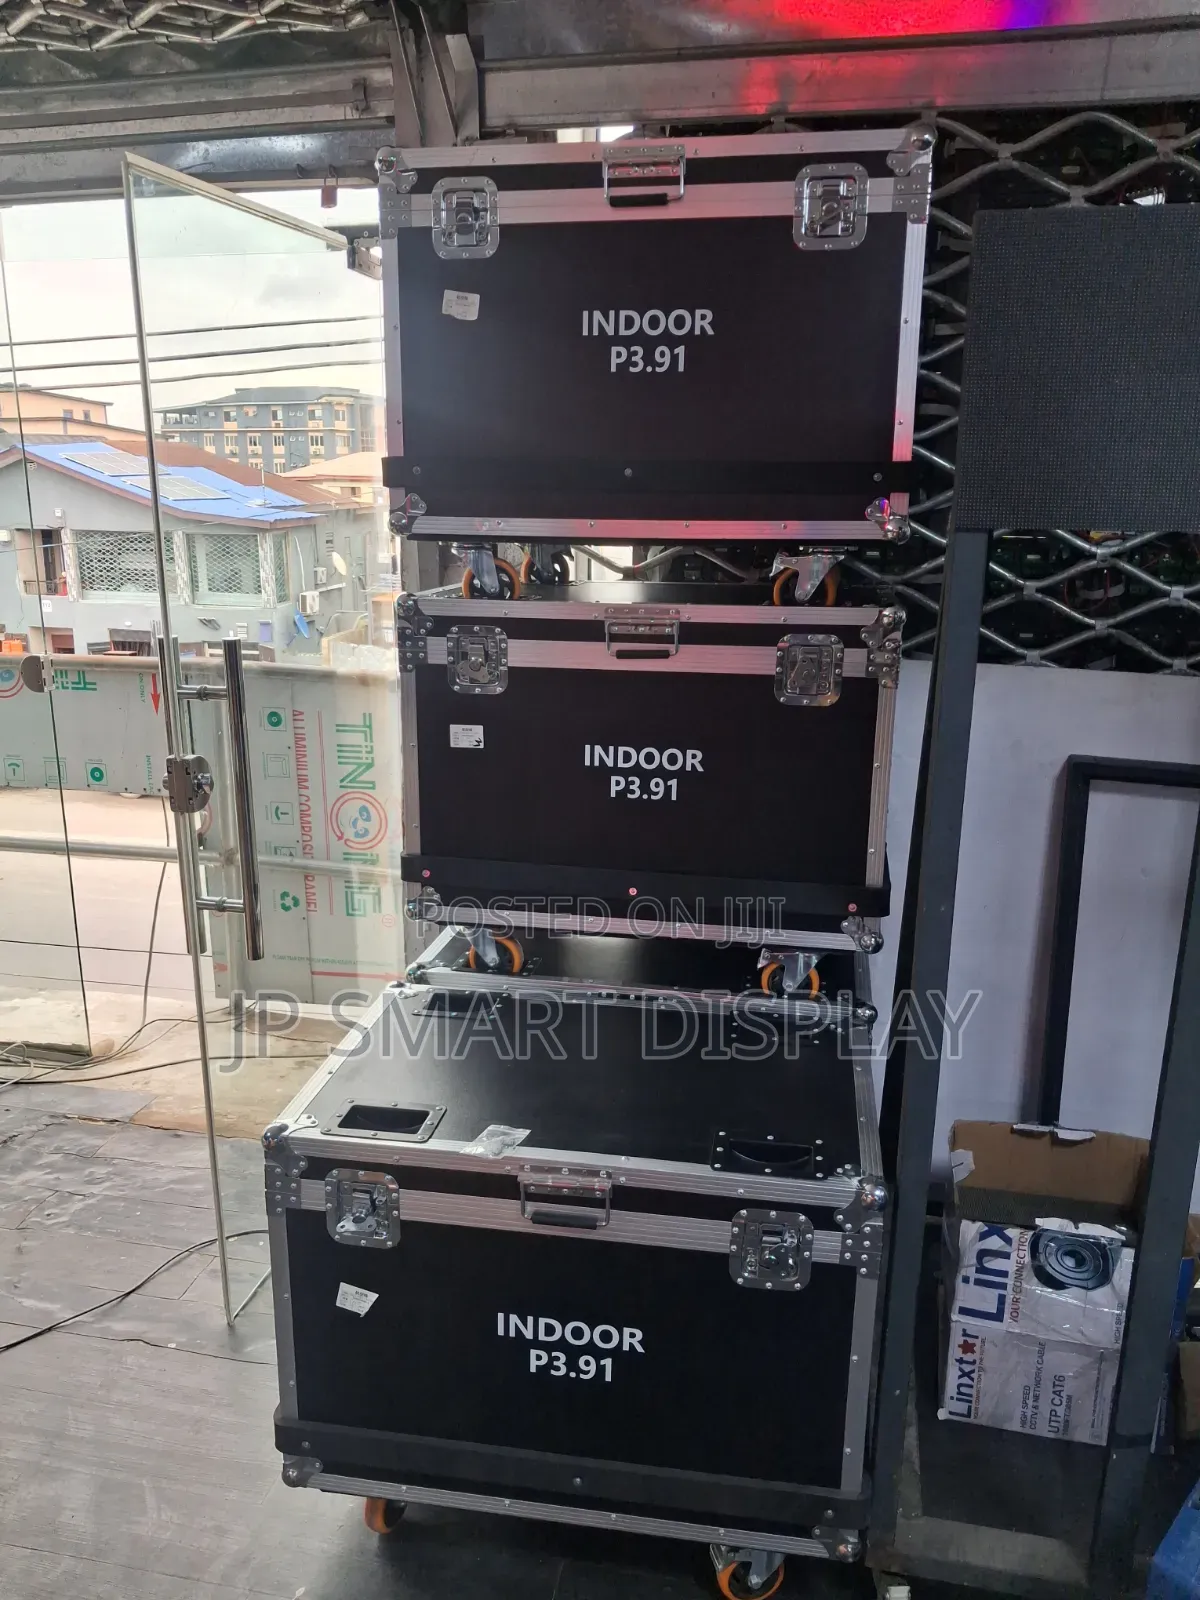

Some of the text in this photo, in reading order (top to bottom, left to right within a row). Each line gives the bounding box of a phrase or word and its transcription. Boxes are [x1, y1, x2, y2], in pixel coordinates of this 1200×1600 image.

[581, 308, 715, 337] INDOOR
[609, 344, 687, 373] P3.91
[584, 743, 705, 773] INDOOR
[609, 775, 679, 802] P3.91
[1008, 1296, 1021, 1323] YOUR
[1114, 1302, 1124, 1344] HIGH SPEED
[496, 1312, 645, 1353] INDOOR
[529, 1349, 614, 1383] P3.91
[1037, 1341, 1046, 1366] CABLE
[1032, 1366, 1043, 1403] NETWORK
[1020, 1385, 1031, 1428] HIGH SPEED
[1048, 1374, 1066, 1434] UTP CAT6
[1029, 1412, 1038, 1430] CCTV
